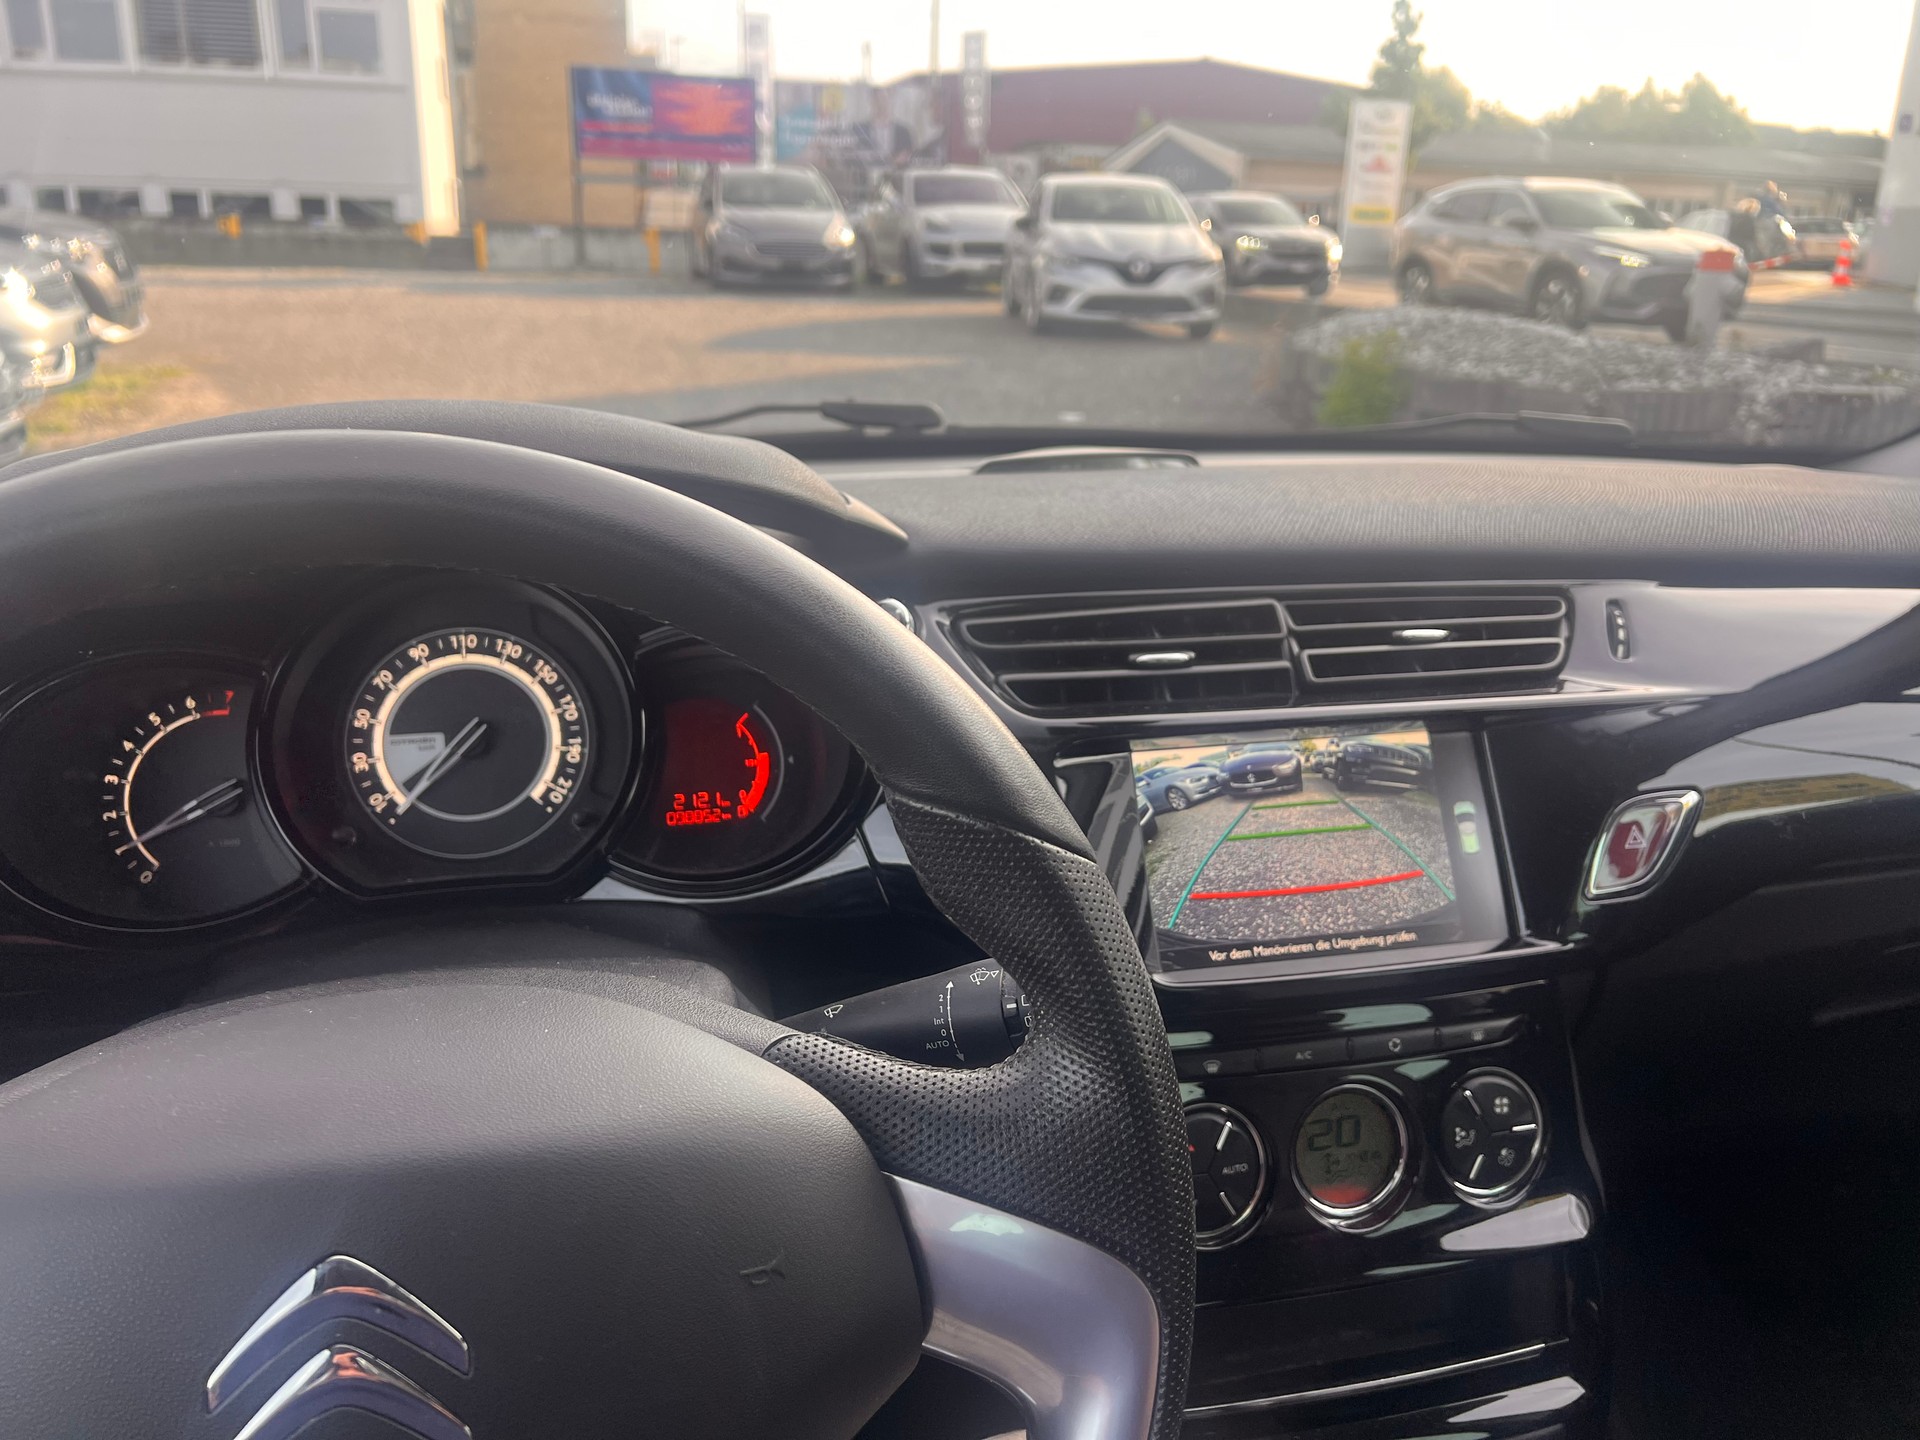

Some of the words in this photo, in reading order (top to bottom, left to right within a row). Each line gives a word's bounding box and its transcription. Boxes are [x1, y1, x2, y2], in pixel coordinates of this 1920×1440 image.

[450, 634, 478, 650] 110
[496, 639, 522, 659] 130
[407, 643, 429, 662] 90
[533, 659, 558, 685] 150
[371, 669, 394, 691] 70
[185, 695, 196, 709] 6
[225, 690, 235, 703] 7
[559, 694, 579, 721] 170
[149, 712, 161, 727] 5
[354, 708, 371, 730] 50
[123, 740, 135, 752] 4
[567, 736, 582, 763] 190
[352, 752, 369, 774] 30
[104, 774, 119, 786] 3
[549, 777, 572, 804] 210
[369, 792, 388, 813] 10
[102, 810, 117, 822] 2
[140, 870, 153, 884] 0
[1208, 949, 1228, 961] Vor
[1229, 948, 1252, 960] dem
[1253, 943, 1314, 957] Manövrieren
[1315, 939, 1331, 951] die
[1331, 935, 1386, 951] Umgebung
[1385, 930, 1418, 946] prüfen
[938, 994, 944, 1002] 2
[939, 1005, 943, 1013] 1
[933, 1017, 945, 1026] Int
[940, 1029, 947, 1037] 0
[926, 1039, 950, 1050] AUTO
[1307, 1114, 1361, 1152] 20
[1222, 1162, 1249, 1175] AUTO
